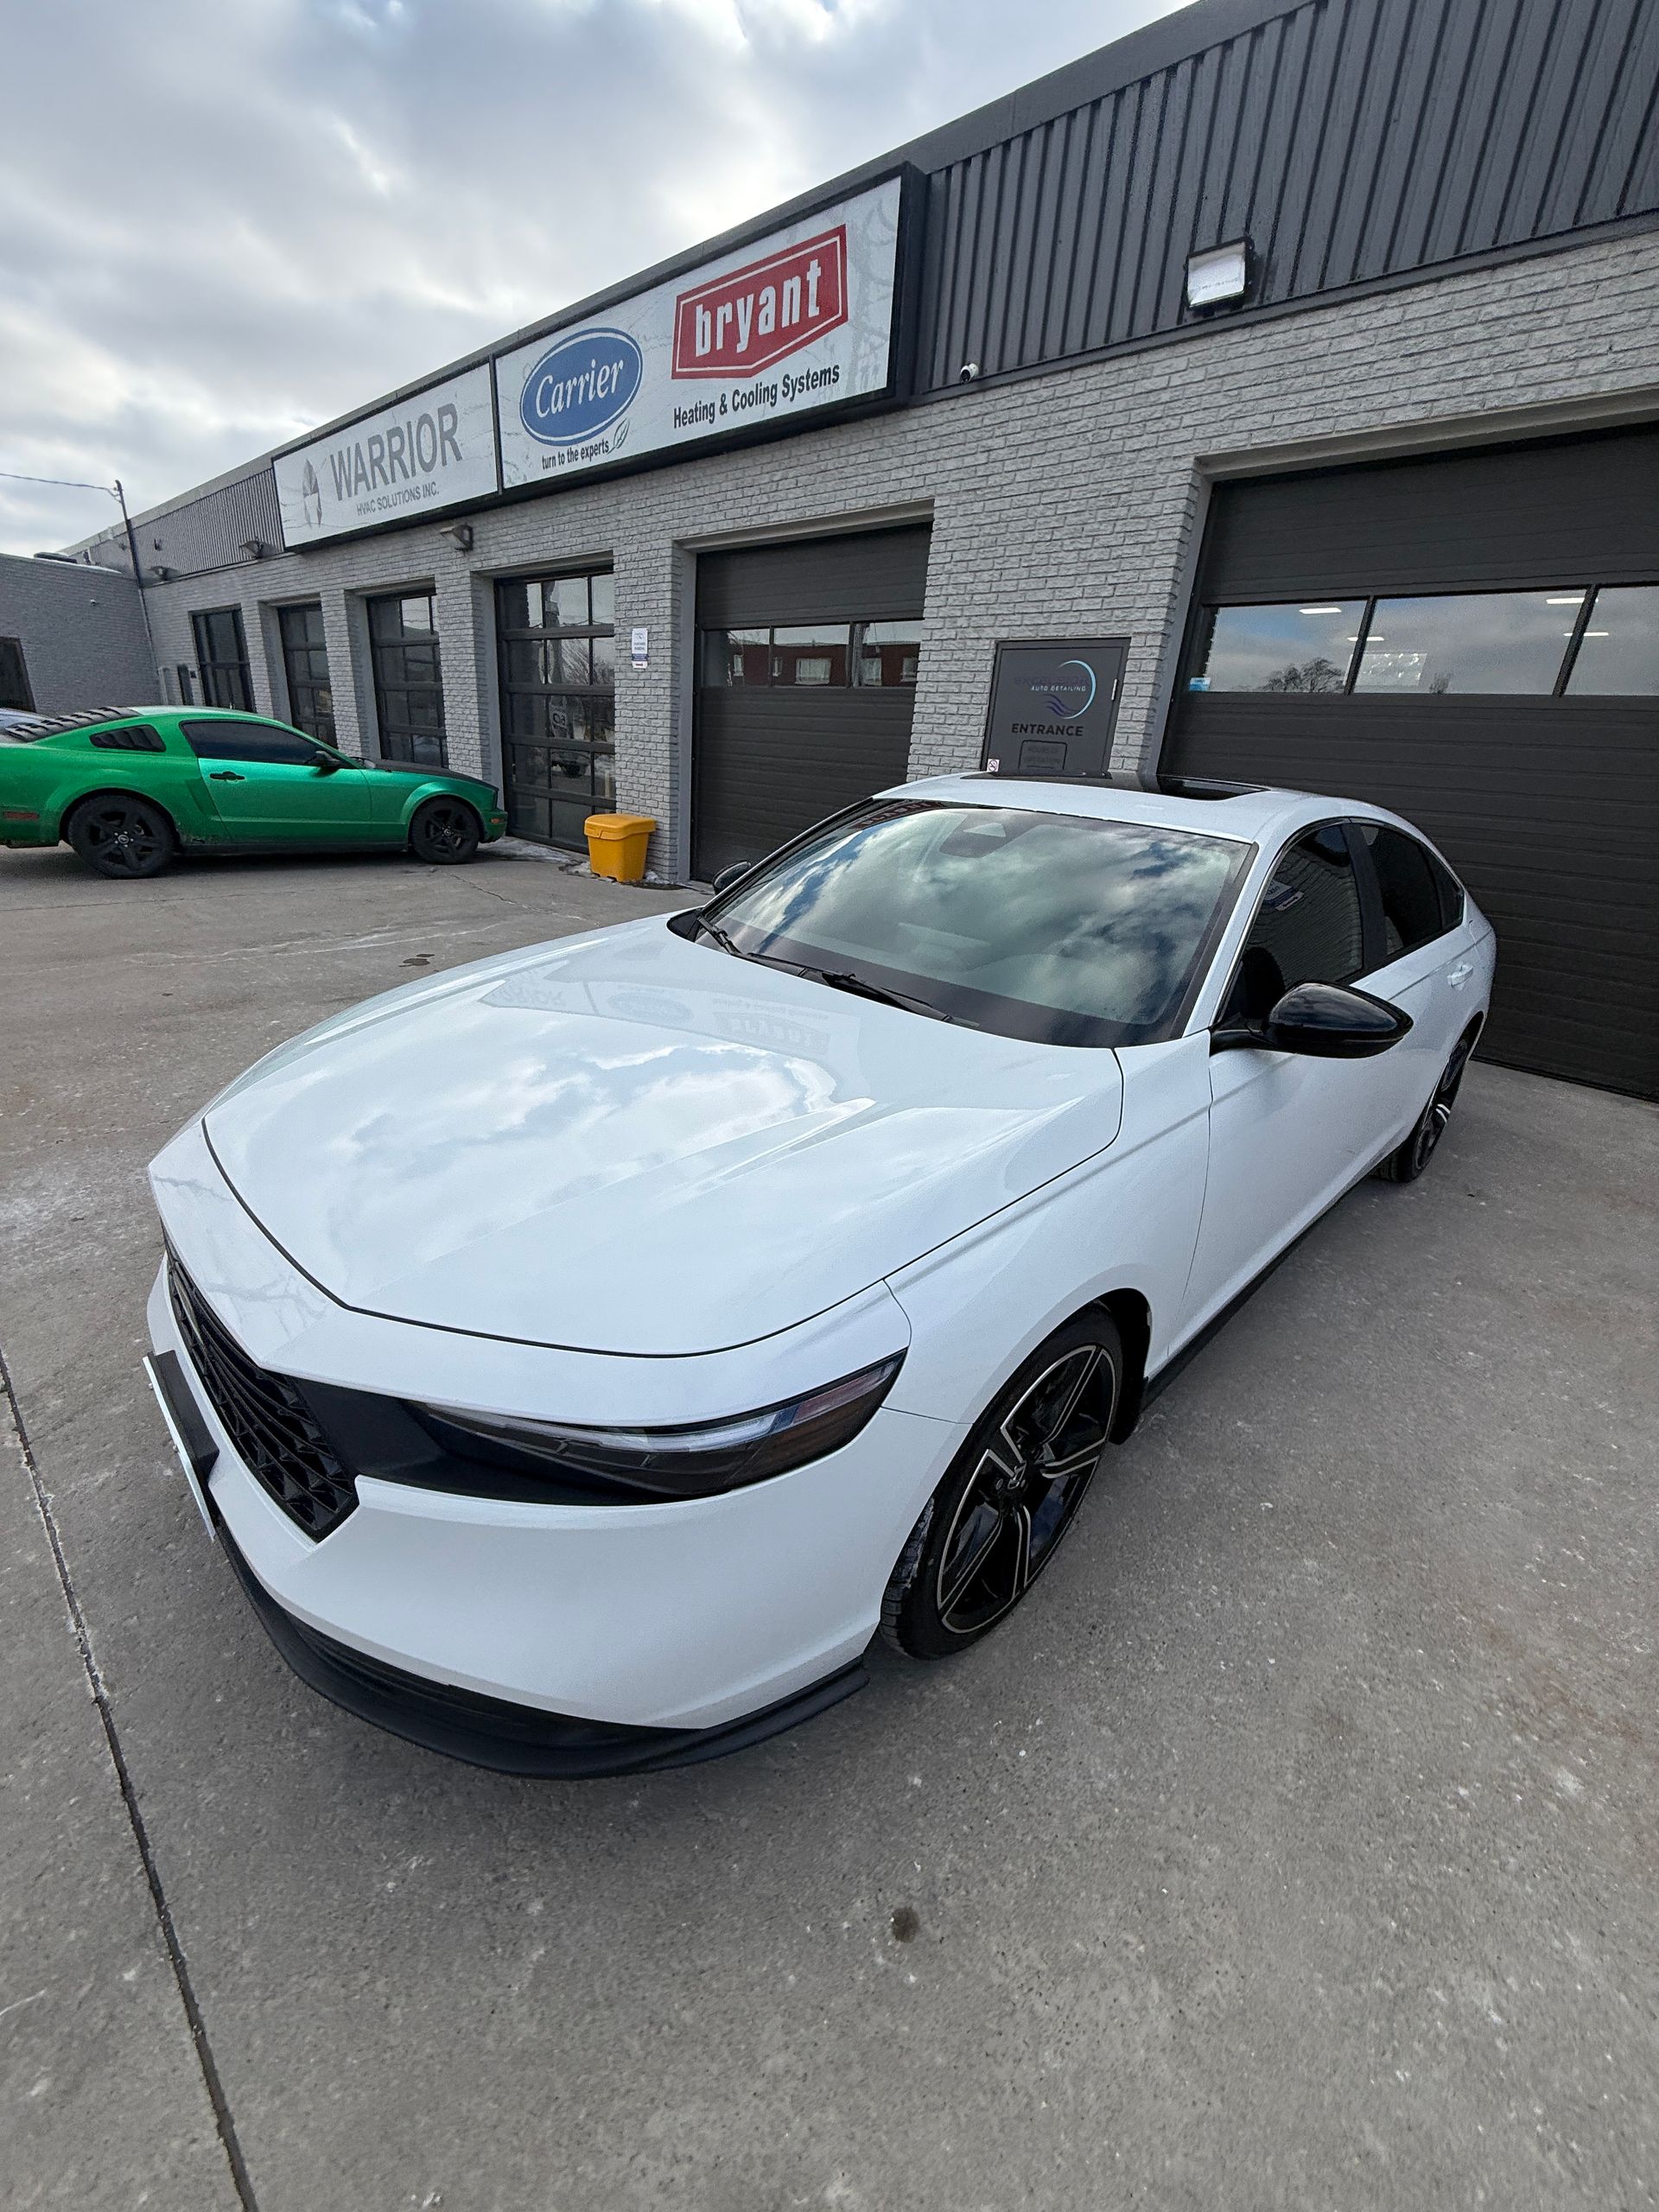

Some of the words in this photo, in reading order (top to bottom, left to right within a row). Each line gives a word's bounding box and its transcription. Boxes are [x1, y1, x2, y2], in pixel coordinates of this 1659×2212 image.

[695, 258, 822, 358] bryant
[536, 359, 624, 418] Carrier
[673, 399, 715, 429] Heating
[719, 392, 728, 416] &
[732, 381, 778, 412] Cooling
[781, 364, 841, 403] Systems
[329, 403, 463, 501] WARRIOR
[542, 454, 556, 470] turn
[557, 451, 565, 466] to
[567, 447, 579, 464] the
[581, 439, 609, 462] experts
[356, 499, 376, 516] HVAC
[378, 486, 422, 512] SOLUTIONS
[423, 480, 440, 499] INC.
[1011, 722, 1084, 736] ENTRANCE
